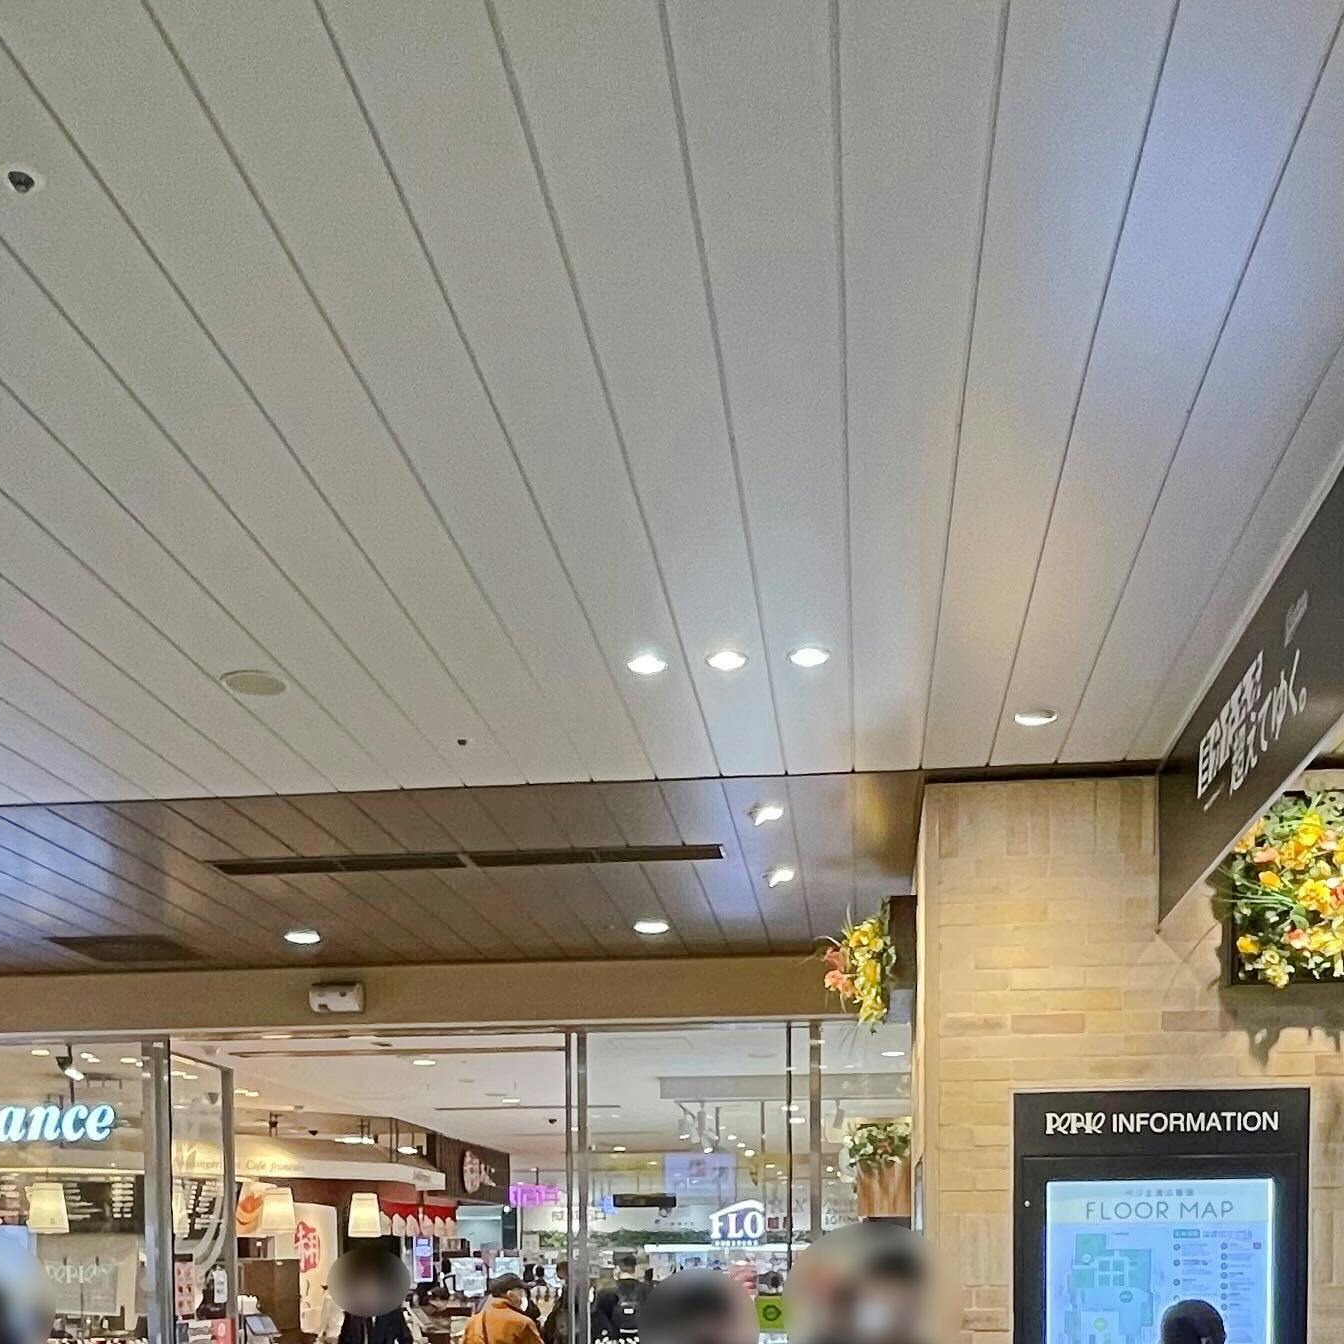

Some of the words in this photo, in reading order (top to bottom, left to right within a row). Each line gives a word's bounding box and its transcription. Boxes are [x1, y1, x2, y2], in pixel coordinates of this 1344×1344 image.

[1112, 1111, 1280, 1133] INFORMATION
[1086, 1201, 1169, 1220] FLOOR
[1180, 1200, 1233, 1219] MAP
